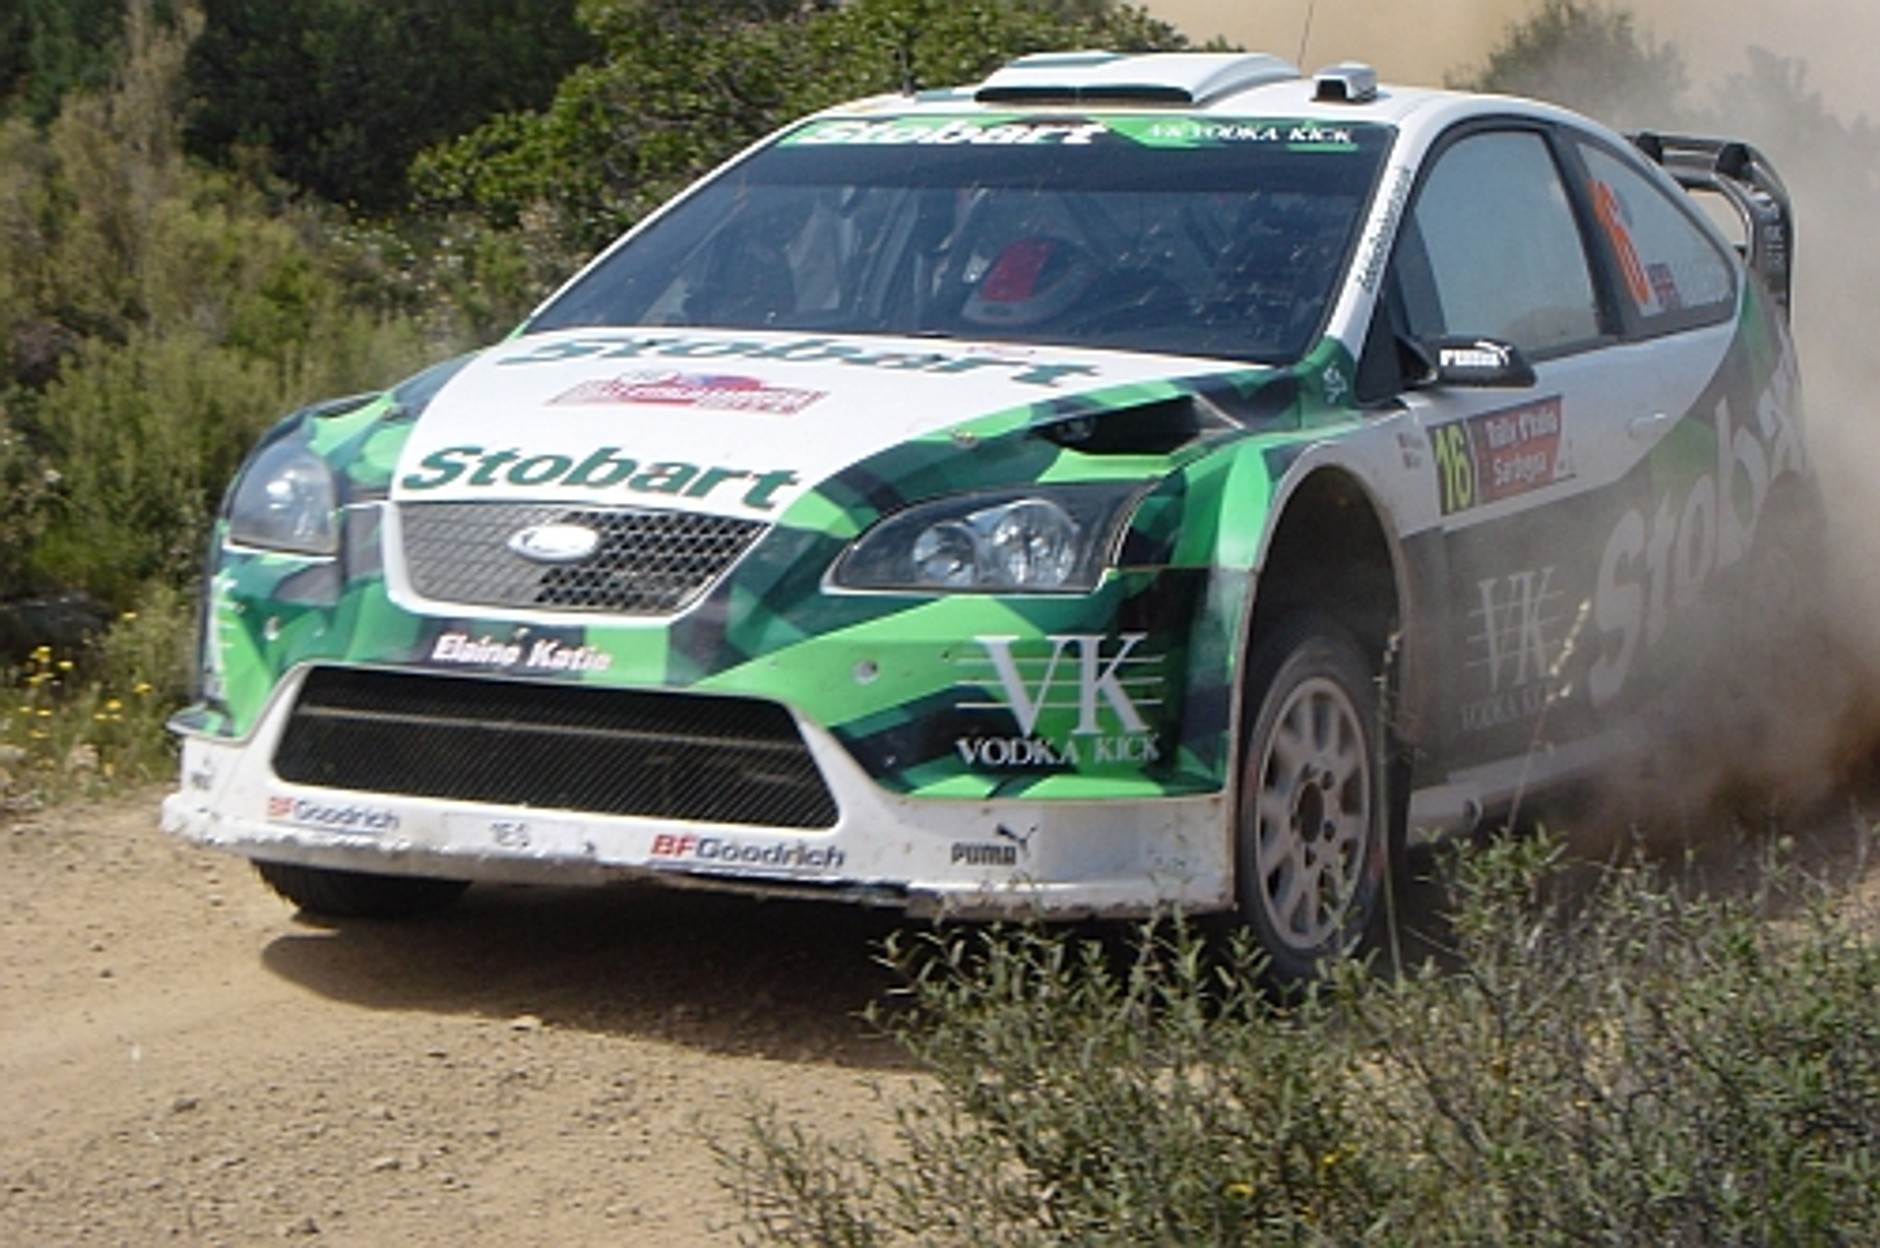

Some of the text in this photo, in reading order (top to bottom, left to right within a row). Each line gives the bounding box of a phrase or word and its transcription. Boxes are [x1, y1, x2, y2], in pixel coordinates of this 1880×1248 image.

[797, 120, 1108, 144] Stobart
[497, 336, 1100, 388] Stobart
[402, 446, 799, 510] Stobart
[1435, 423, 1473, 511] 16
[432, 634, 612, 671] Elaine Katie
[972, 632, 1149, 738] VK
[955, 733, 1160, 766] VODKA KICK
[267, 796, 400, 830] BFGoodrich
[650, 833, 847, 870] BFGoodrich
[951, 842, 1017, 866] PUMA
